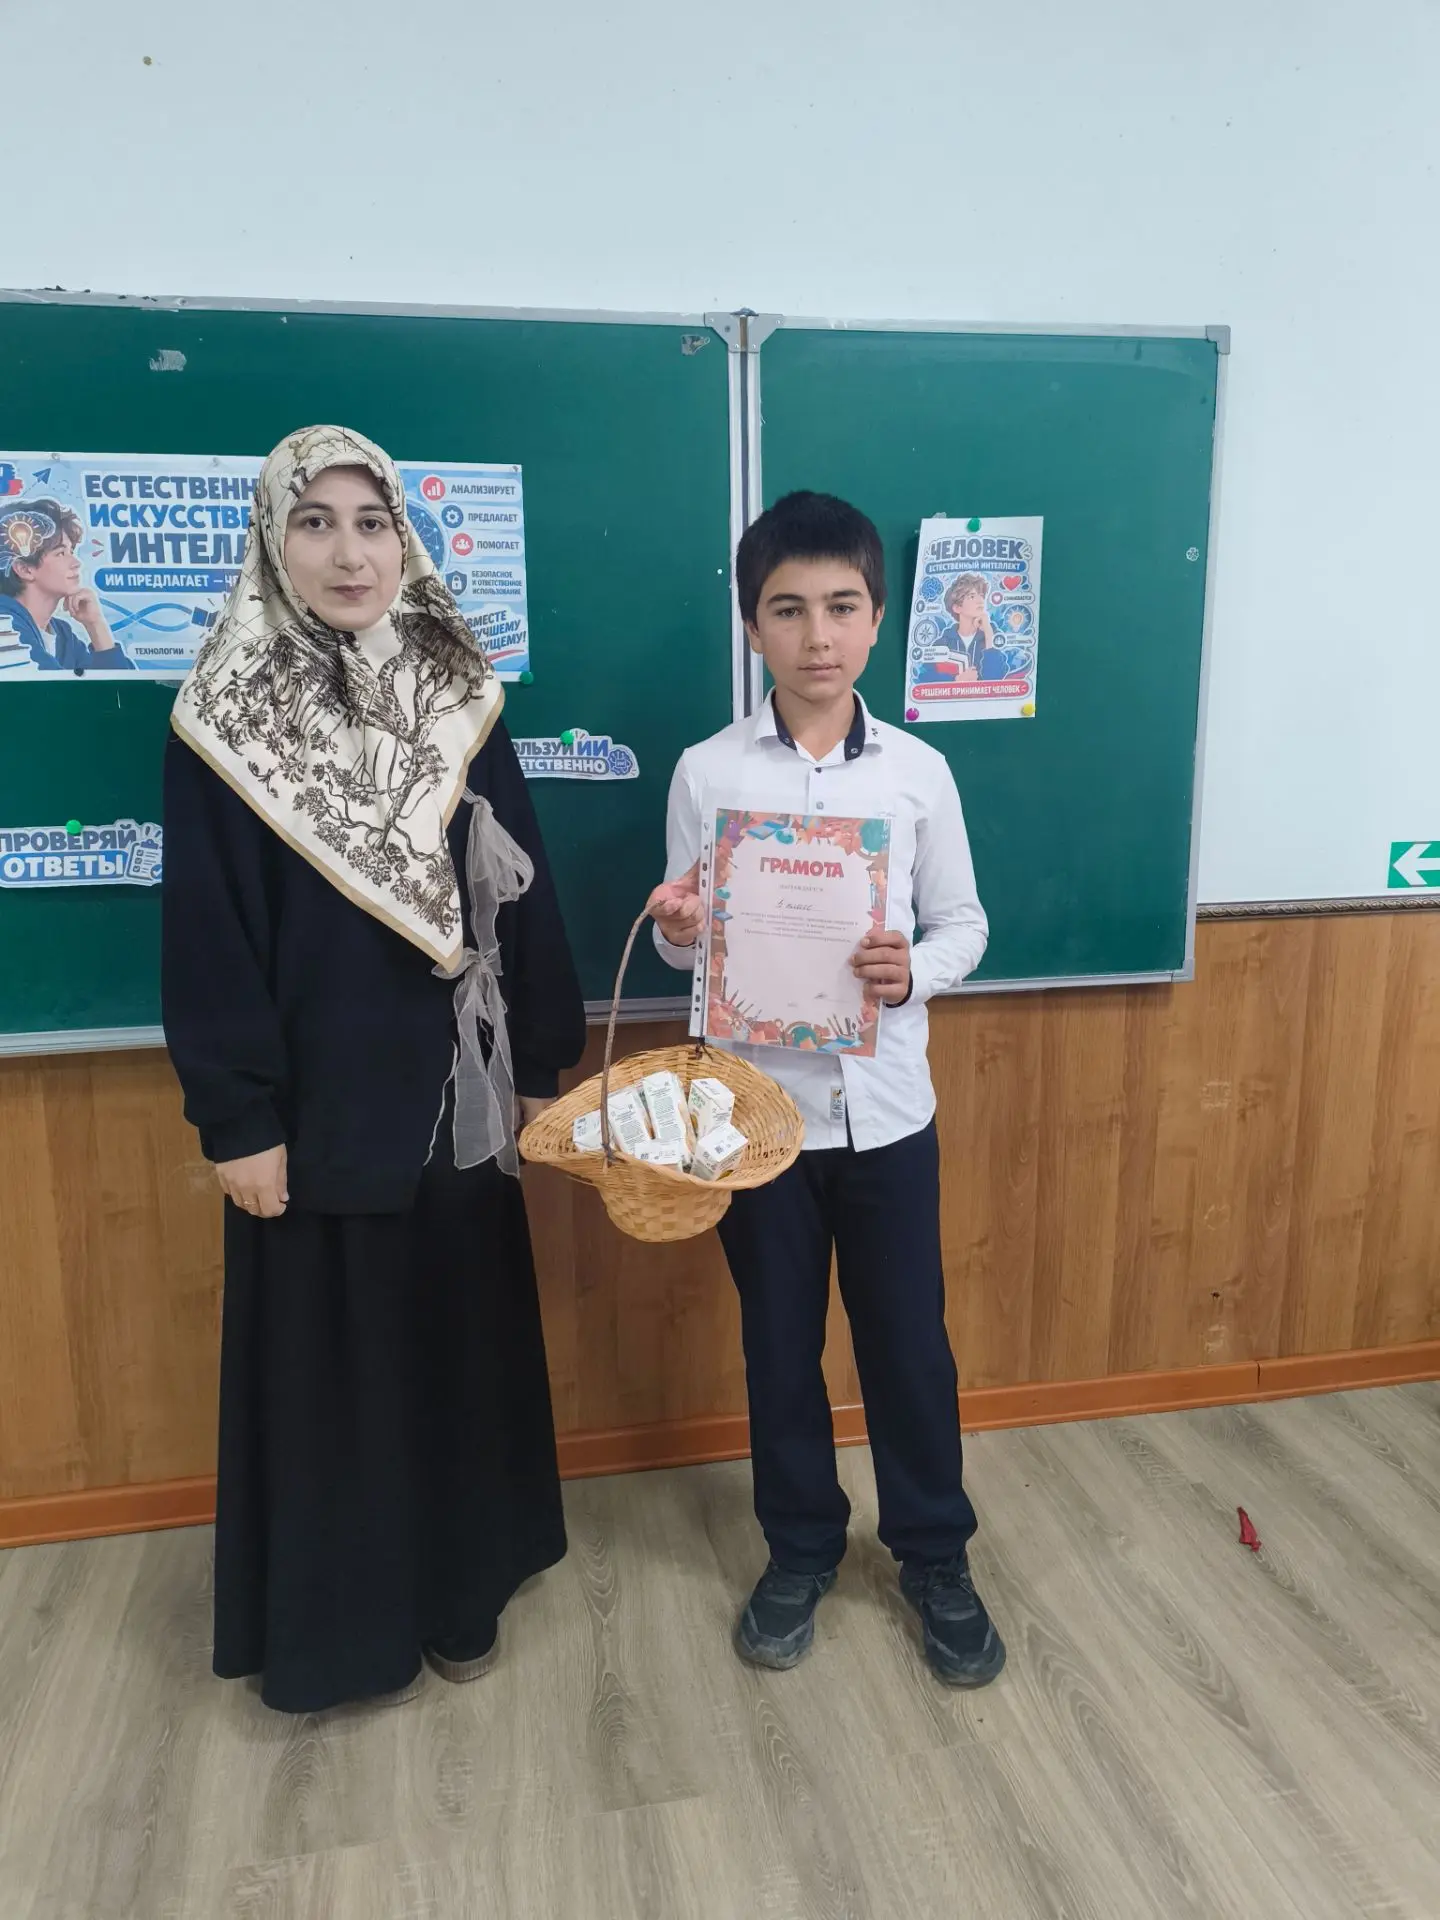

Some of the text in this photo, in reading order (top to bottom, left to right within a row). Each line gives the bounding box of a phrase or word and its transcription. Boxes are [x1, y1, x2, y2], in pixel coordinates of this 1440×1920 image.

[450, 484, 516, 496] АНАЛИЗИРУЕТ
[468, 512, 518, 523] ПРЕДЛАГАЕТ
[476, 540, 520, 550] ПОМОГАЕТ
[931, 538, 1024, 560] ЧЕЛОВЕК
[105, 574, 125, 587] ИИ
[128, 574, 208, 588] ПРЕДЛАГАЕТ
[134, 647, 184, 656] ТЕХНОЛОГИИ
[920, 685, 1021, 697] РЕШЕНИЕ ПРИНИМАЕТ ЧЕЛОВЕК
[577, 739, 609, 757] ИИ
[0, 823, 137, 852] ПРОВЕРЯЙ
[3, 854, 123, 879] ОТВЕТЫ
[759, 856, 844, 878] ГРАМОТА
